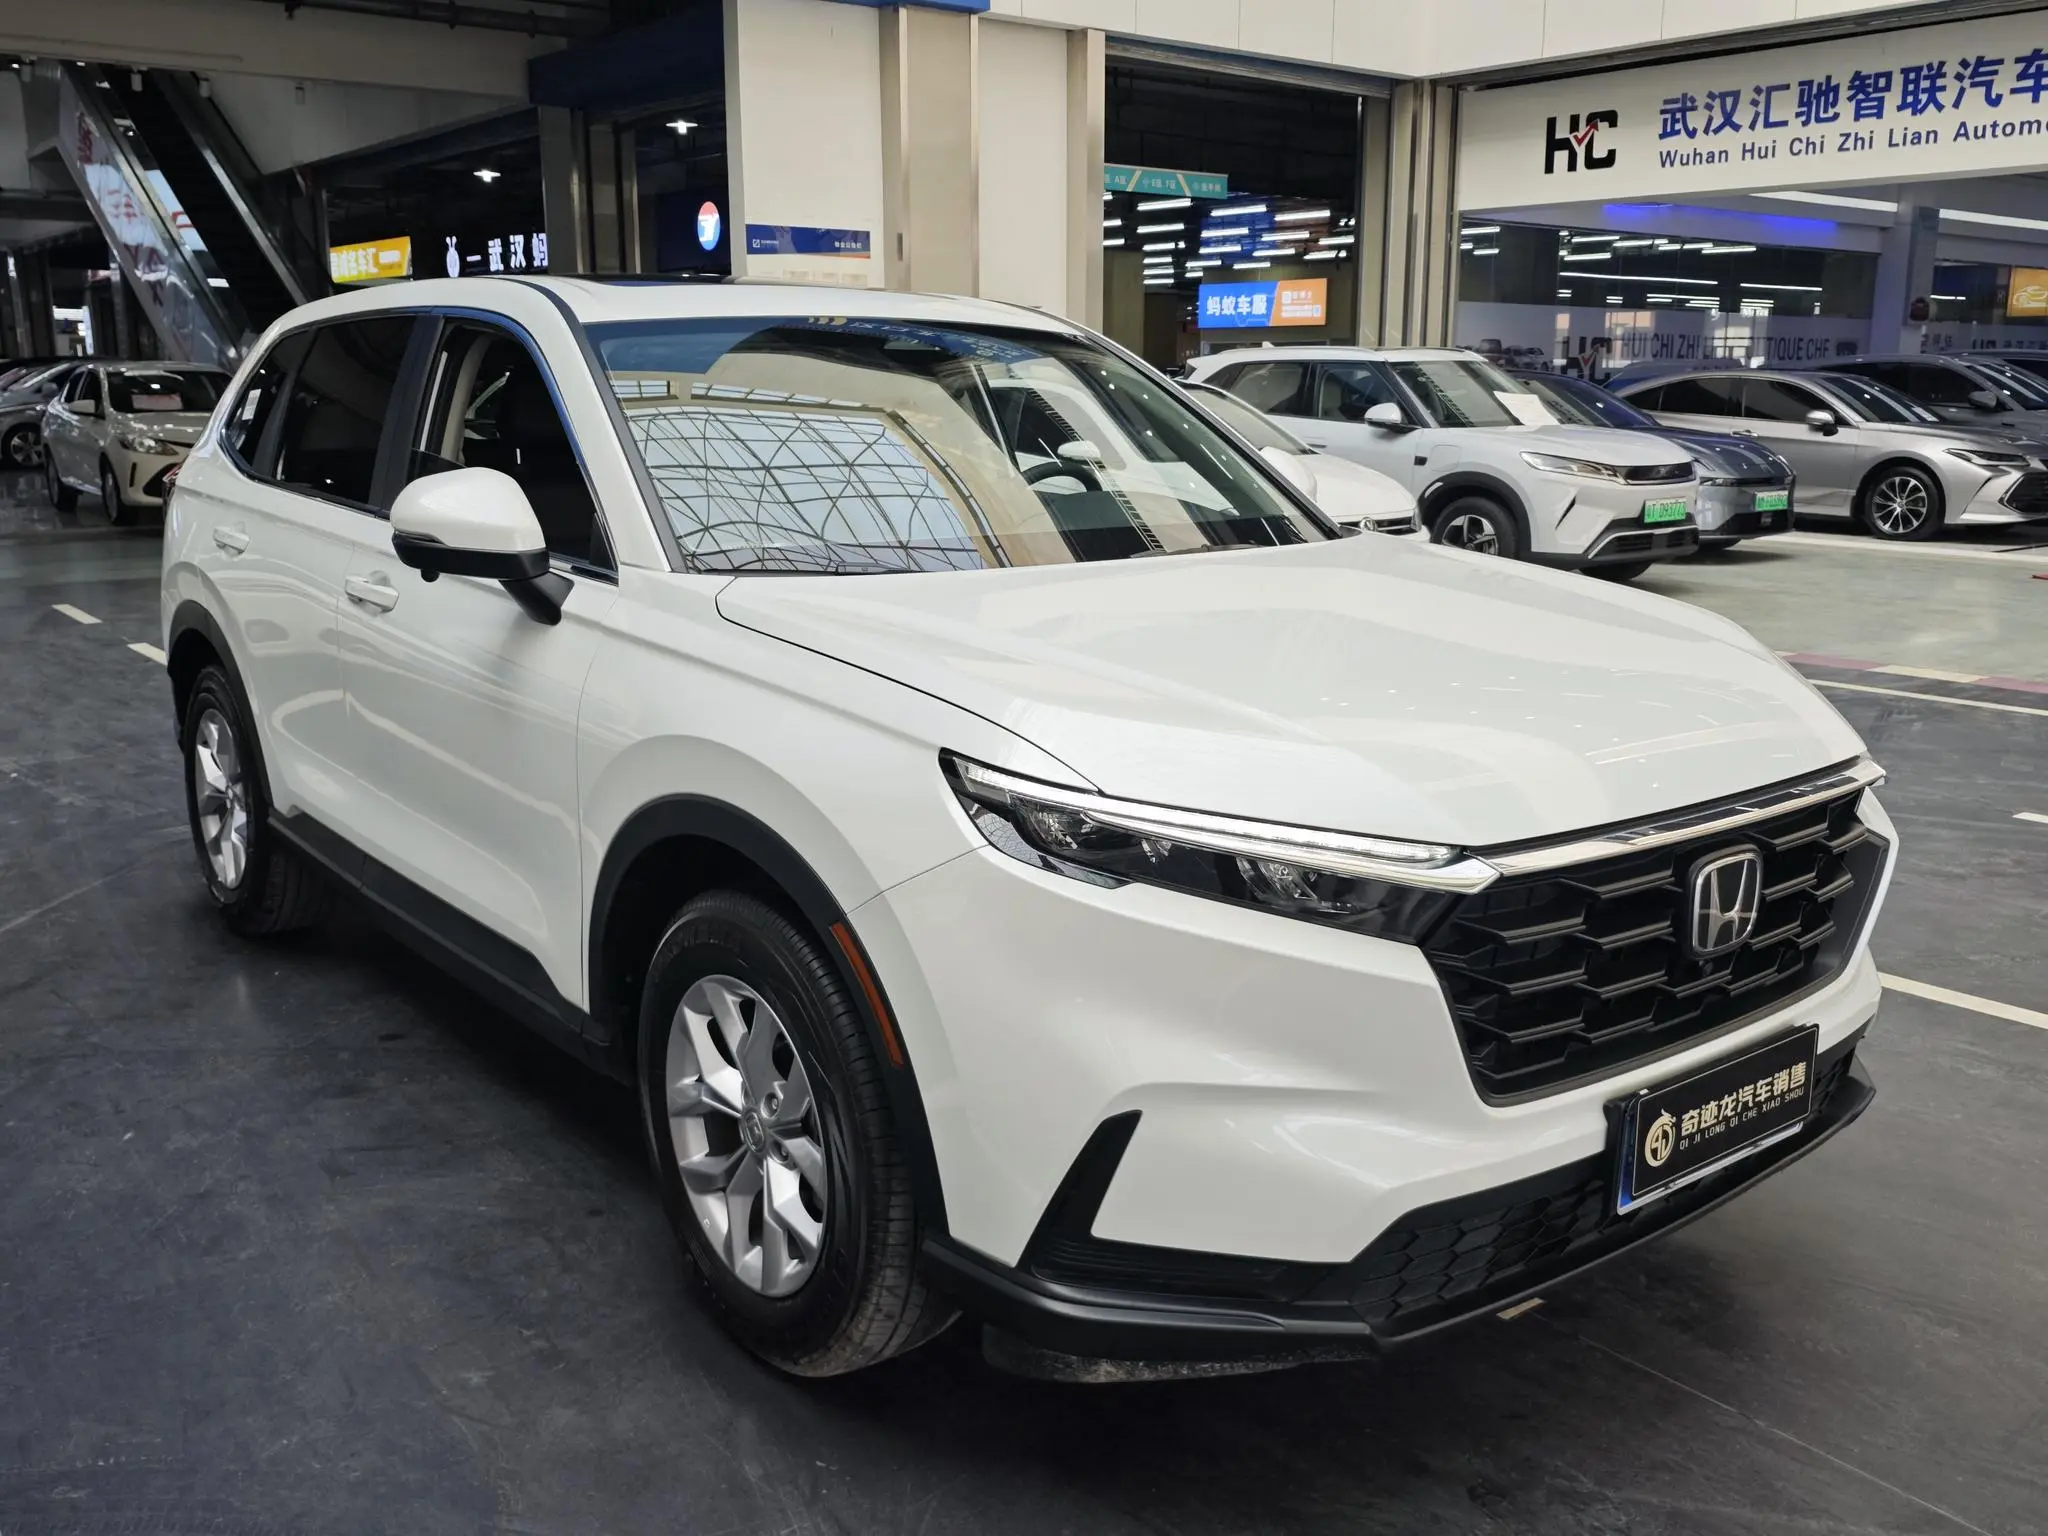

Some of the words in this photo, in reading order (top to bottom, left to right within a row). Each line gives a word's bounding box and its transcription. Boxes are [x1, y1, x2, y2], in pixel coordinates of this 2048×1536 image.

[1658, 48, 2048, 140] 武汉汇驰智联汽车
[1544, 109, 1618, 175] HC
[1658, 148, 1729, 169] Wuhan
[1741, 140, 1777, 161] Hui
[1789, 134, 1825, 157] Chi
[1837, 130, 1874, 152] Zhi
[1888, 127, 1939, 148] Lian
[1952, 117, 2048, 142] Autom
[1621, 332, 1648, 360] HUI
[1650, 332, 1674, 360] CHI
[1681, 1062, 1807, 1137] 奇迹龙汽车销售
[1693, 1133, 1701, 1144] JI
[1705, 1122, 1726, 1139] LONG
[1742, 1107, 1758, 1121] CHE
[1762, 1097, 1781, 1113] XIAO
[1785, 1086, 1805, 1102] SHOU
